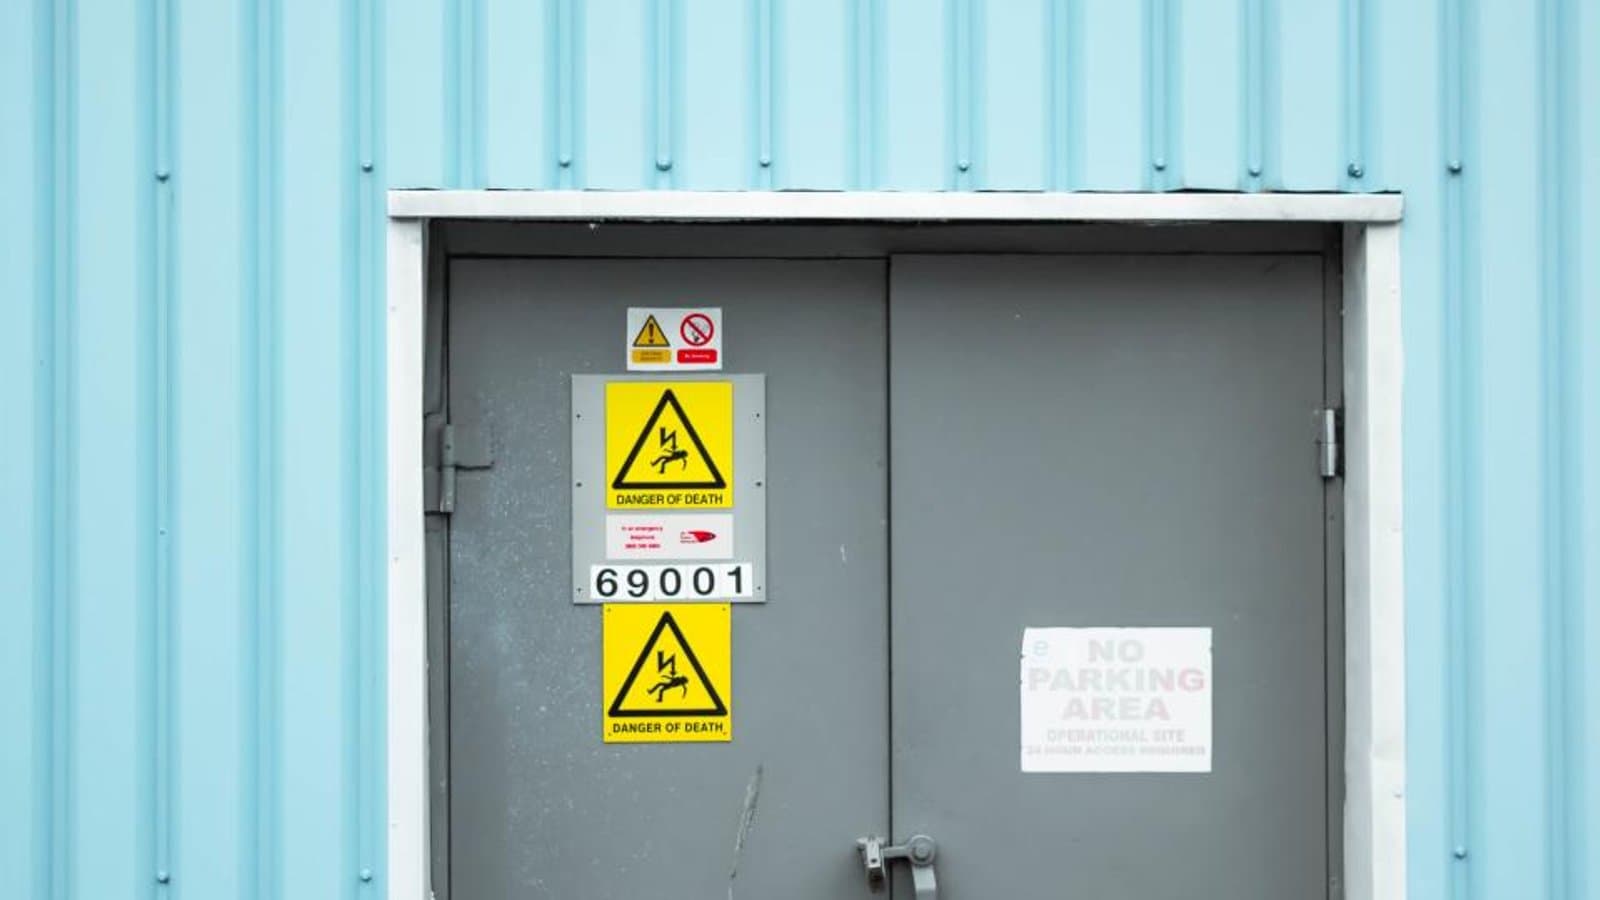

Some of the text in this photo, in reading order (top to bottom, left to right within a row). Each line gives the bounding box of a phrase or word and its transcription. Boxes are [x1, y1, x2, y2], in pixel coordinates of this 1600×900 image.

[616, 493, 723, 505] DANGER OF DEATH
[596, 565, 742, 598] 69001
[1088, 639, 1145, 662] NO
[1028, 667, 1206, 692] PARKING
[1062, 697, 1170, 720] AREA
[612, 721, 724, 734] DANGER OF DEATH
[1047, 729, 1186, 743] OPERATIONAL SITE
